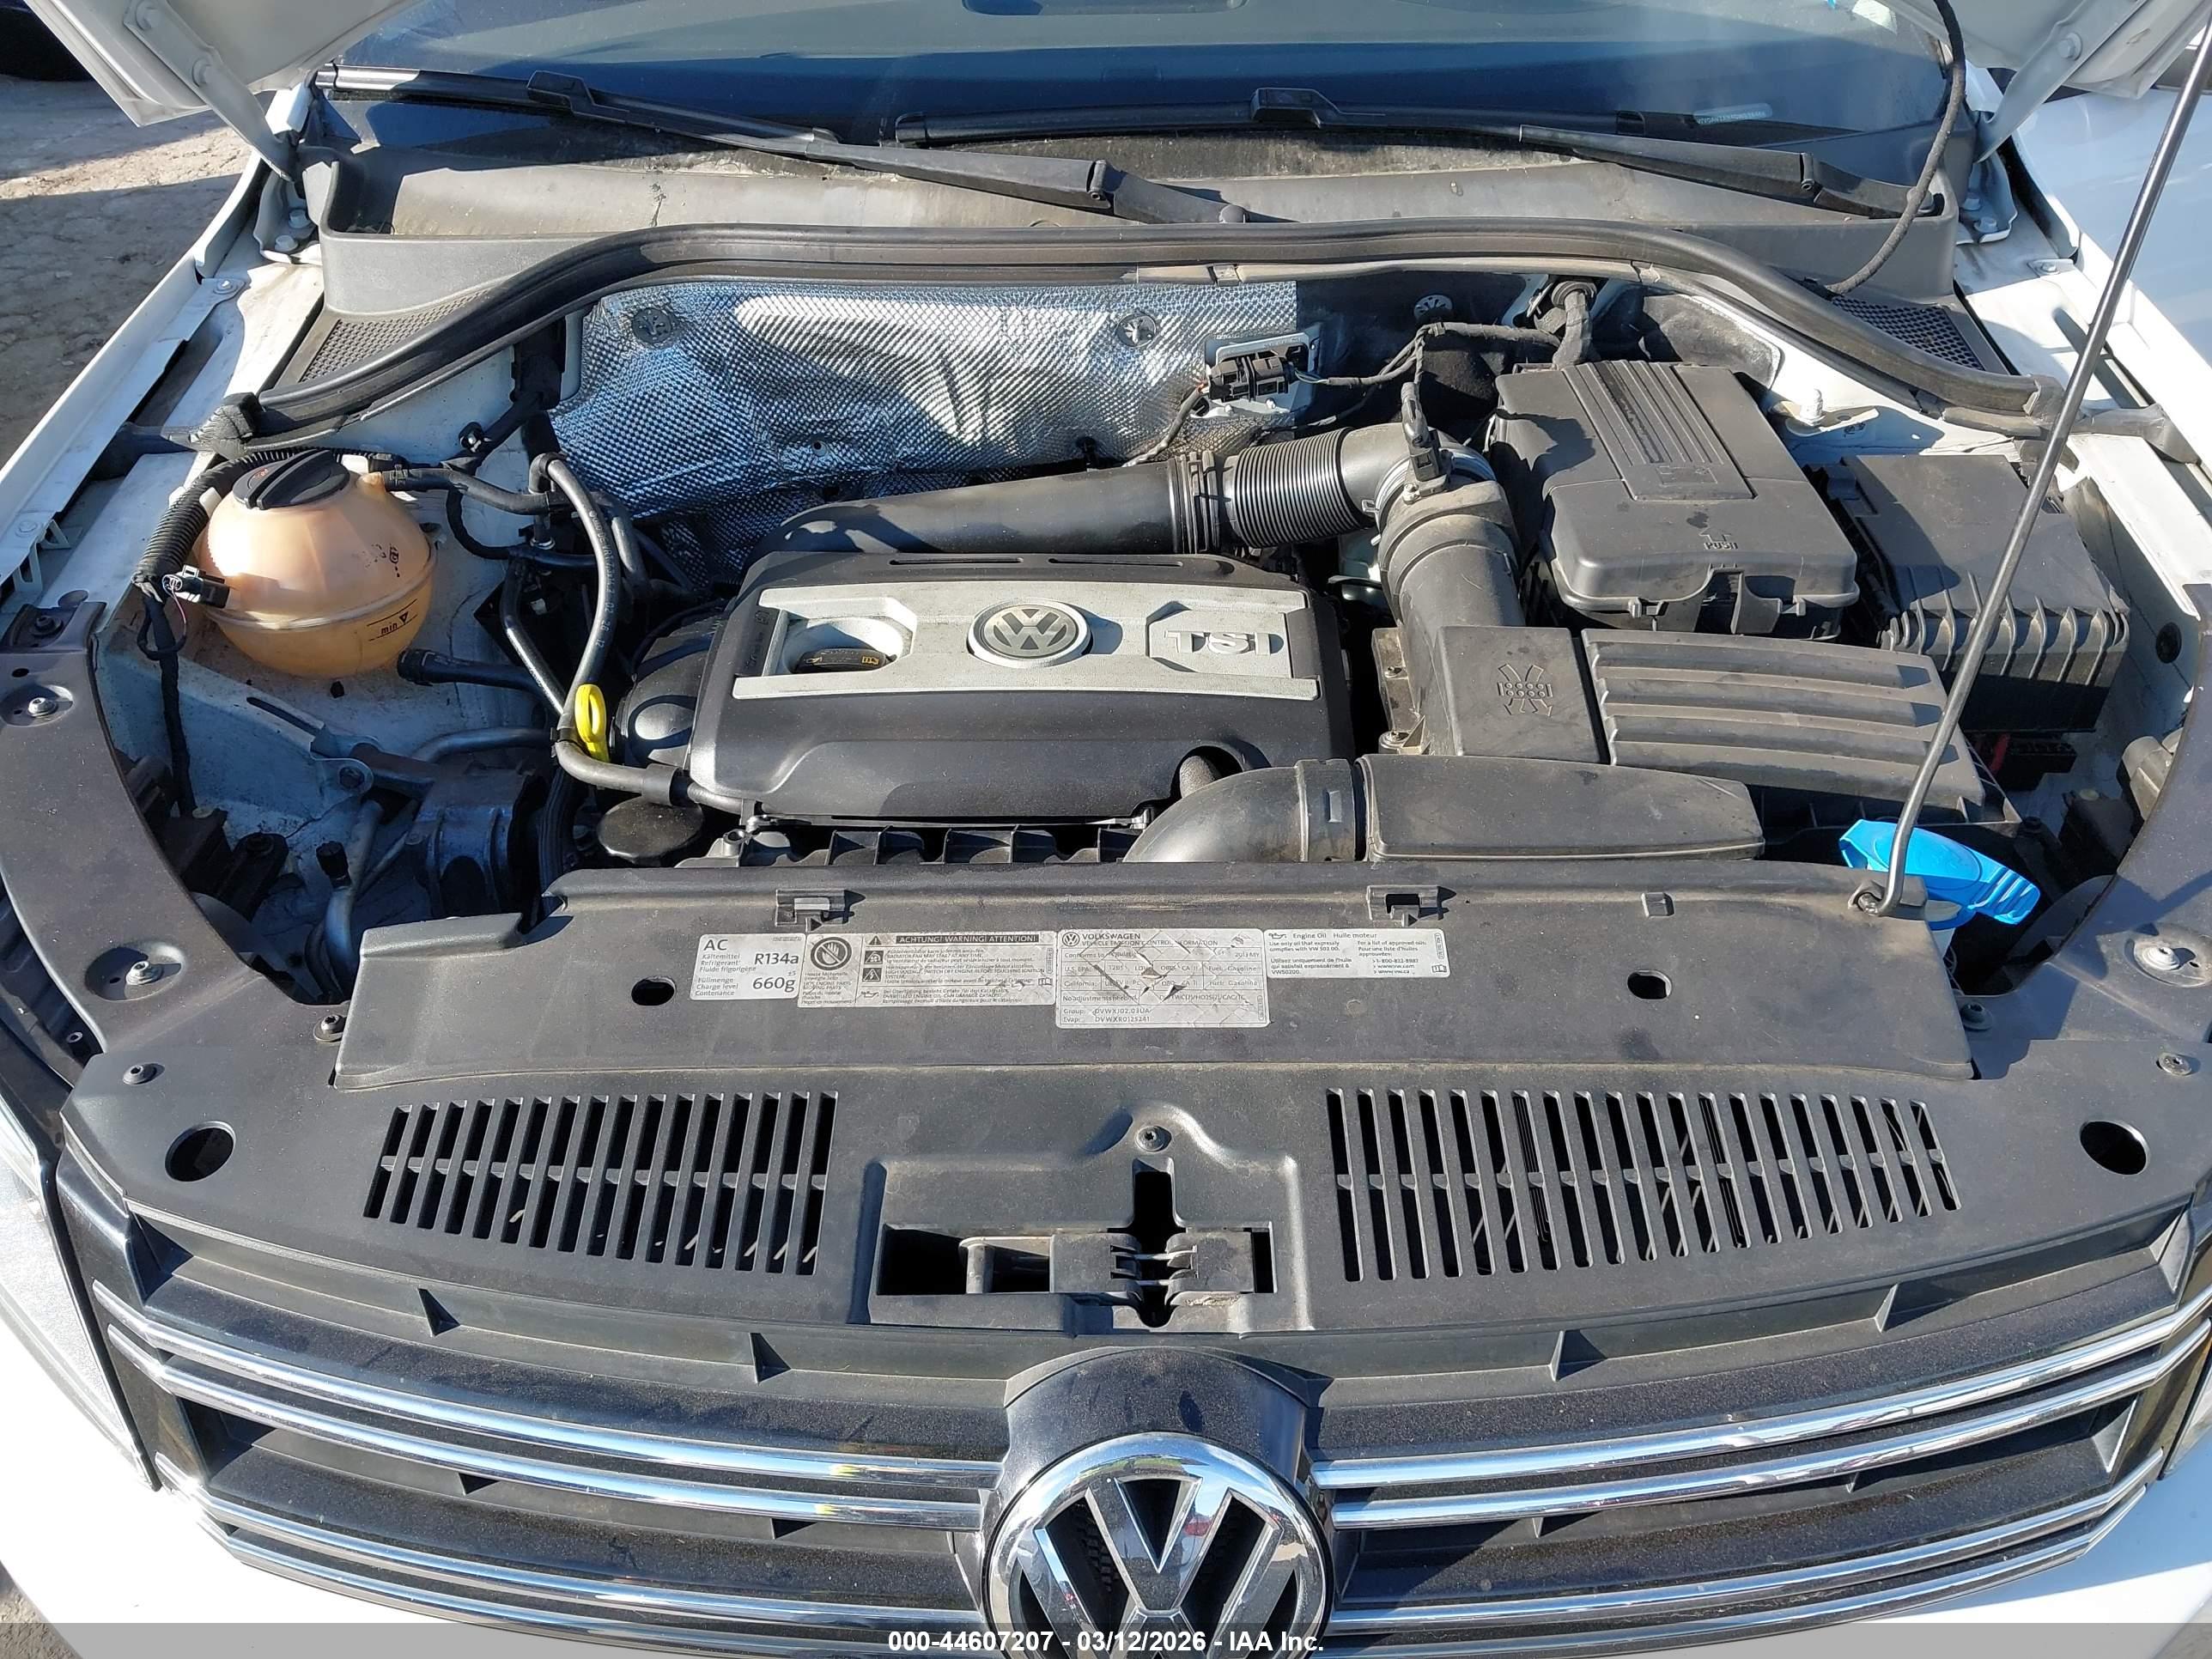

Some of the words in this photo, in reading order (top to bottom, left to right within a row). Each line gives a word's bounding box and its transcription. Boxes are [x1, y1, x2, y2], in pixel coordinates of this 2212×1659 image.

[381, 623, 398, 635] min
[1164, 629, 1273, 656] TSI
[703, 939, 728, 951] AC
[755, 952, 799, 965] R134a
[752, 976, 795, 993] 660g
